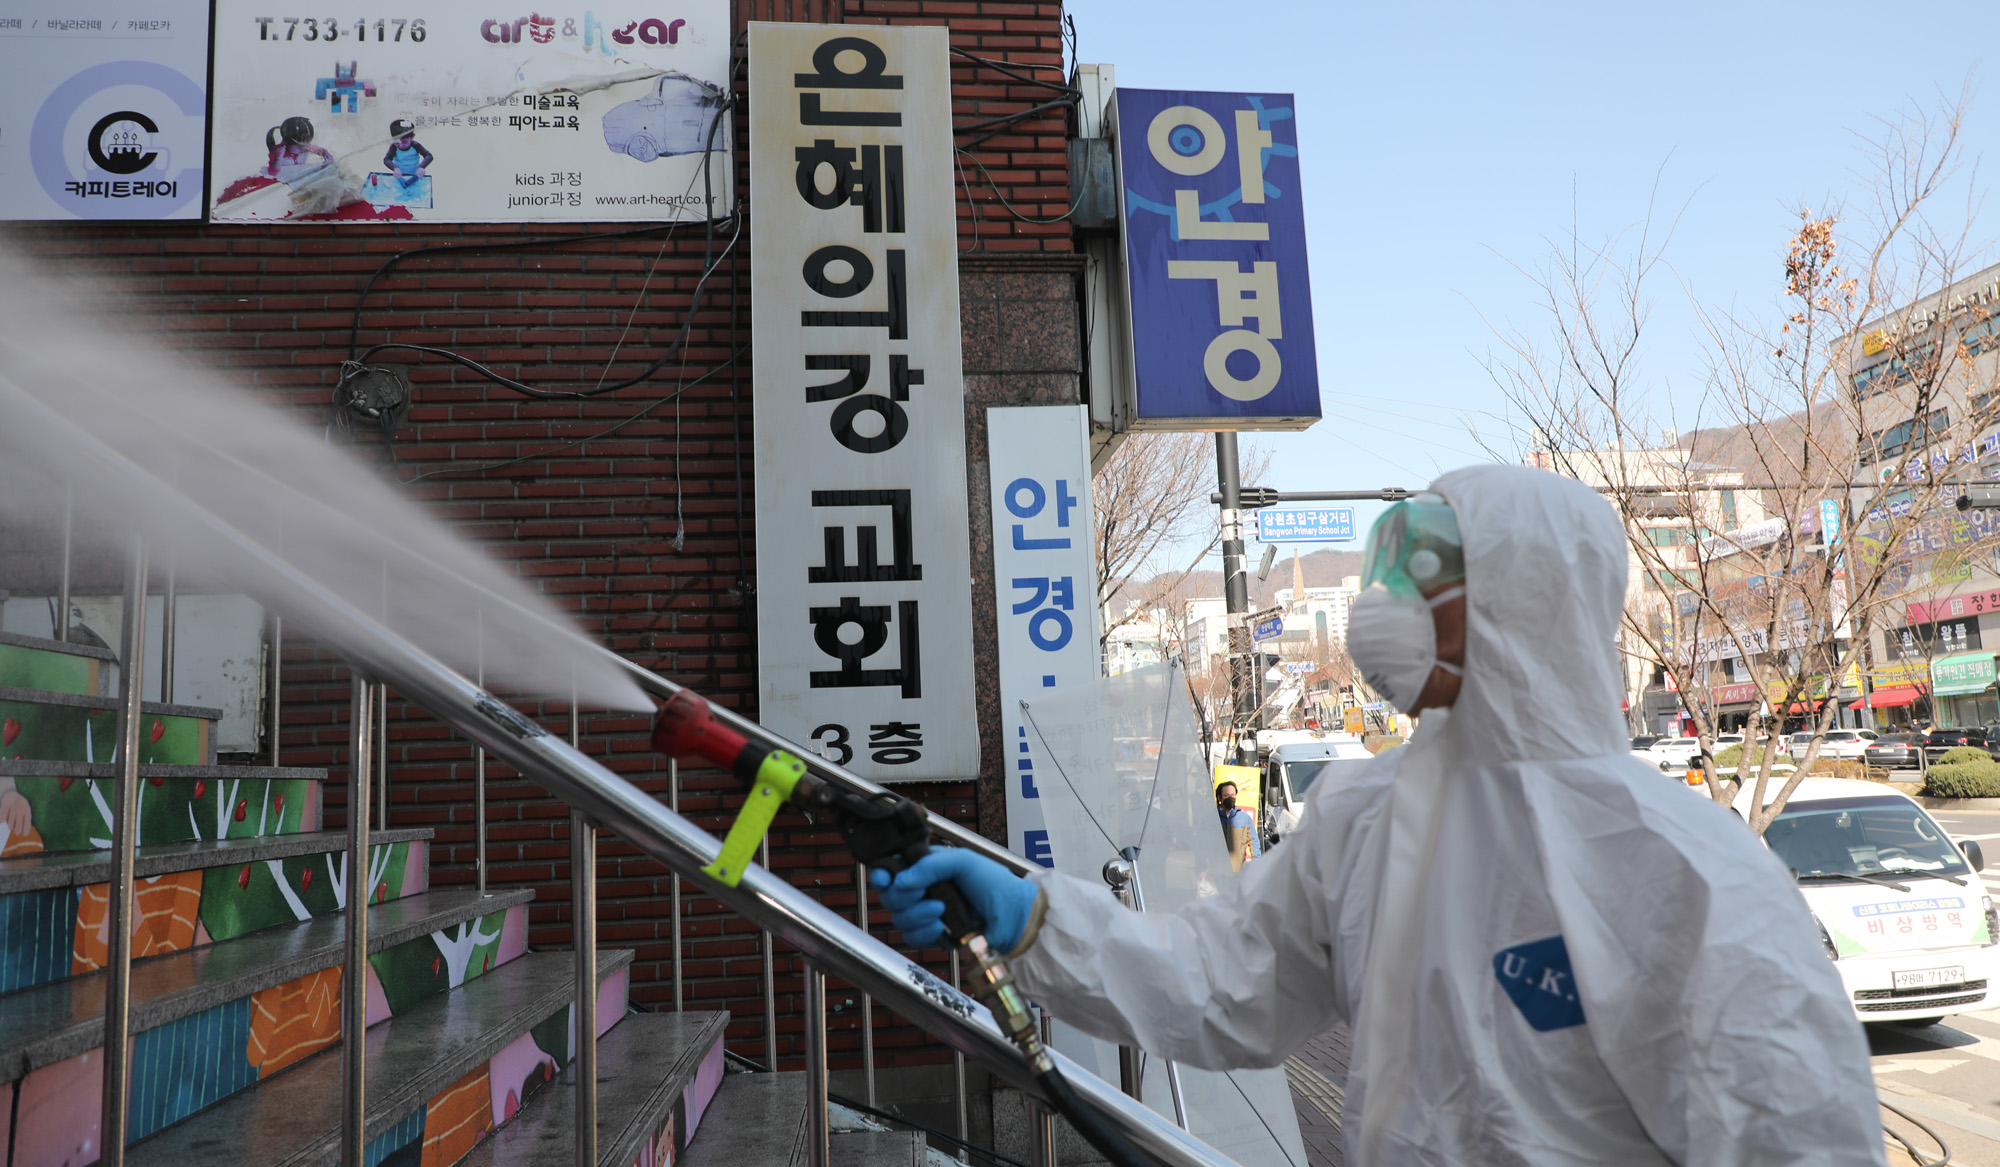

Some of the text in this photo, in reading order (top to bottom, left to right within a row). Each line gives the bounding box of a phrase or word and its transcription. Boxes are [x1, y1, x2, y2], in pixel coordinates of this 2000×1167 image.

[127, 20, 171, 32] 카페모카
[480, 12, 556, 44] art
[523, 94, 580, 111] 미술교육
[467, 116, 502, 127] 행복한
[508, 115, 580, 131] 피아노교육
[515, 172, 582, 187] kids 과정
[65, 181, 177, 198] 커피트레이
[595, 194, 717, 206] www.art-heart.co.r
[1147, 105, 1282, 402] 안경
[1264, 511, 1350, 526] 상원초입구삼거리
[1264, 526, 1293, 538] Sangwon
[1294, 526, 1317, 537] Primary
[1318, 525, 1340, 535] School
[810, 721, 924, 765] 3층
[1928, 969, 1958, 983] 7129
